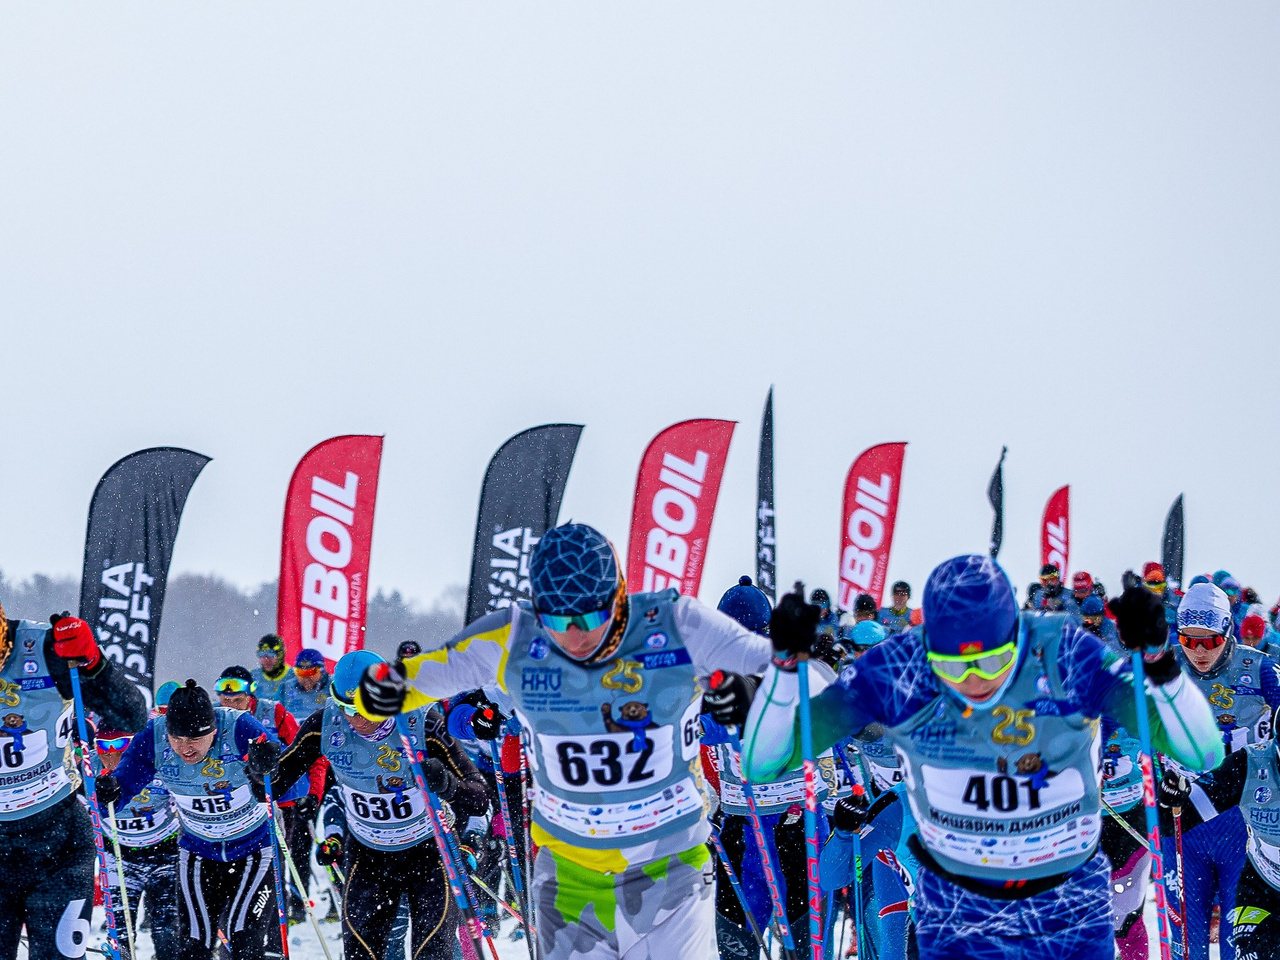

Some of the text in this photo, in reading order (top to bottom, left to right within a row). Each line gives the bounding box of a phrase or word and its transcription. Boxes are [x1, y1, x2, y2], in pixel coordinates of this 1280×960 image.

[301, 471, 360, 663] EBOIL
[600, 658, 645, 693] 25
[991, 705, 1037, 746] 25
[201, 756, 226, 778] 25
[376, 745, 402, 772] 25
[556, 738, 655, 787] 632
[192, 797, 232, 813] 415
[351, 793, 413, 821] 636
[962, 775, 1042, 813] 401
[55, 897, 93, 959] 6
